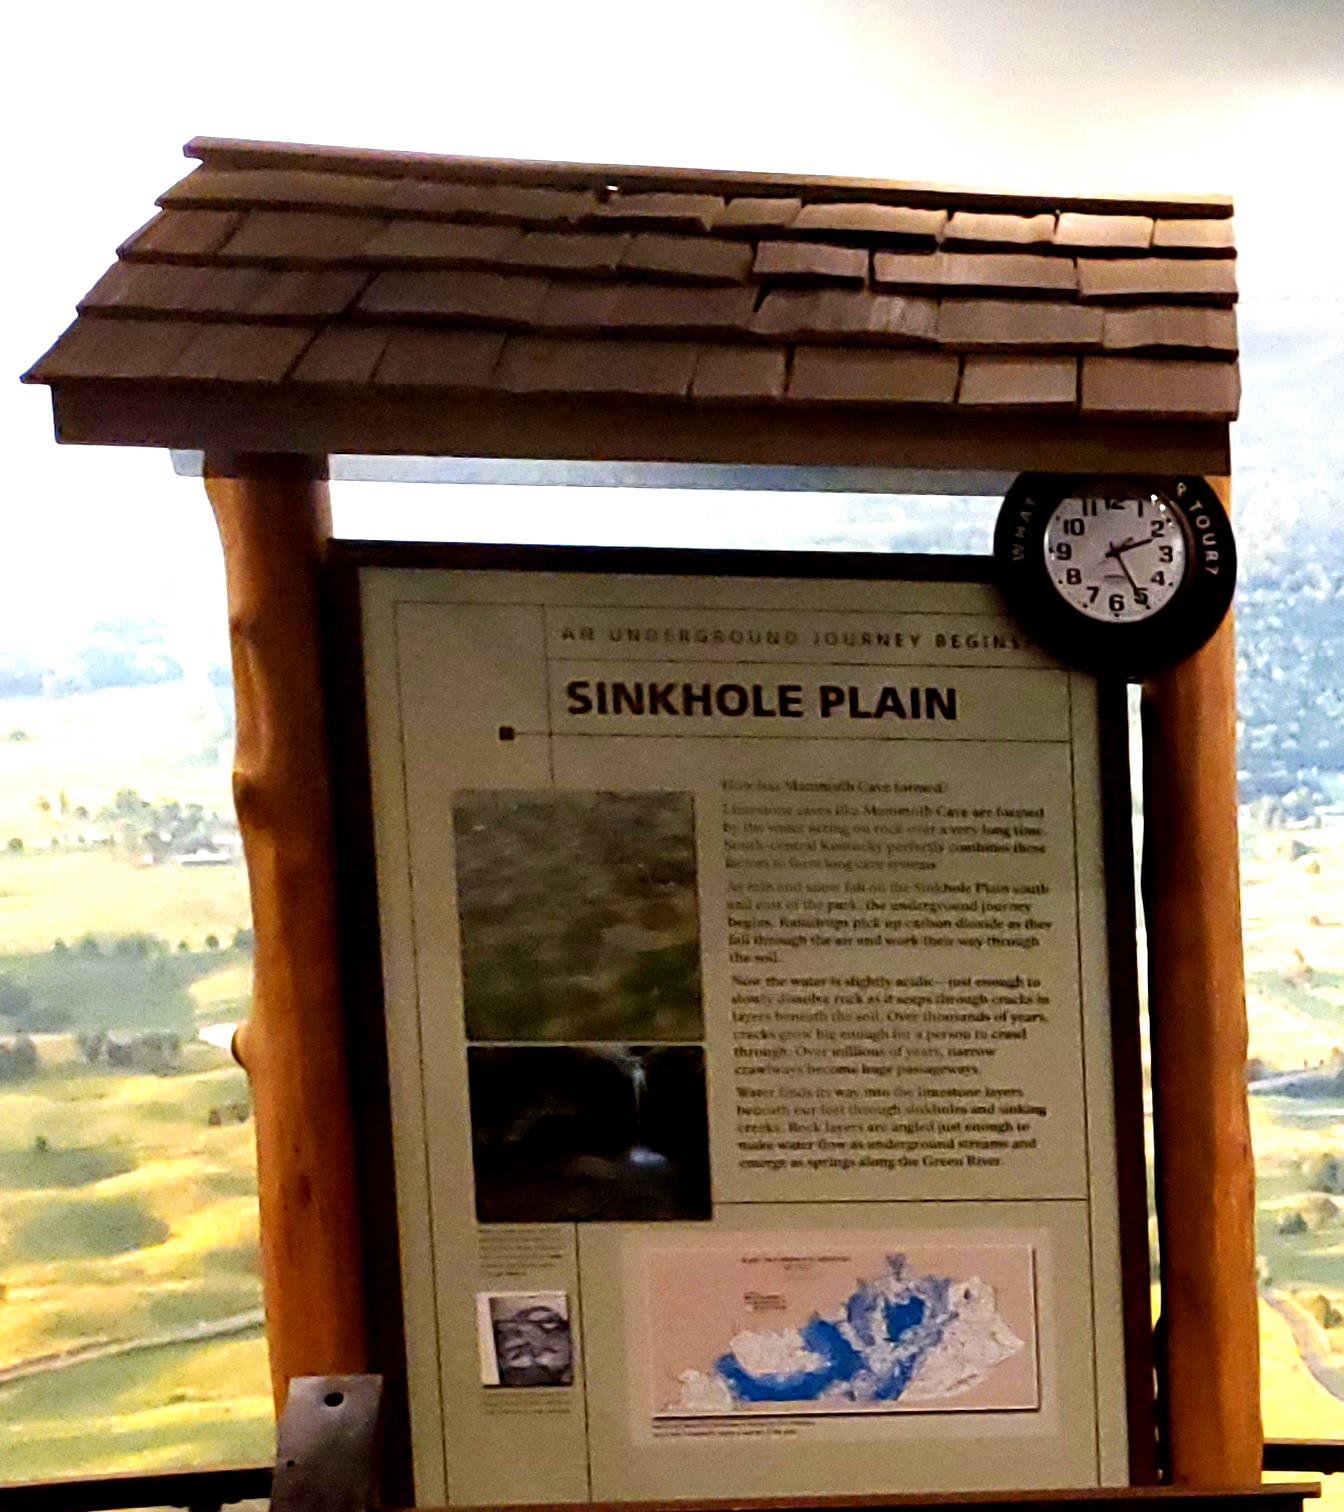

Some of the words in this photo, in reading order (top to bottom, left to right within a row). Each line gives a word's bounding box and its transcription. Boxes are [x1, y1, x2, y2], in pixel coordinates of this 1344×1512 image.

[1063, 518, 1085, 537] 10
[1150, 520, 1165, 538] 2
[1056, 543, 1072, 560] 9
[1159, 545, 1174, 564] 3
[1066, 568, 1082, 585] 8
[1150, 571, 1165, 586] 4
[1086, 586, 1100, 604] 7
[1109, 594, 1125, 612] 6
[1134, 587, 1149, 606] 5
[560, 625, 595, 642] AN
[609, 625, 801, 646] UNDERGROUND
[812, 629, 922, 648] JOURNEY
[565, 679, 805, 720] SINKHOLE
[818, 685, 960, 722] PLAIN
[785, 780, 854, 792] Mammoth
[857, 780, 891, 793] Cave
[862, 805, 932, 818] Mammoth
[935, 806, 970, 818] Cave
[996, 806, 1044, 819] formed
